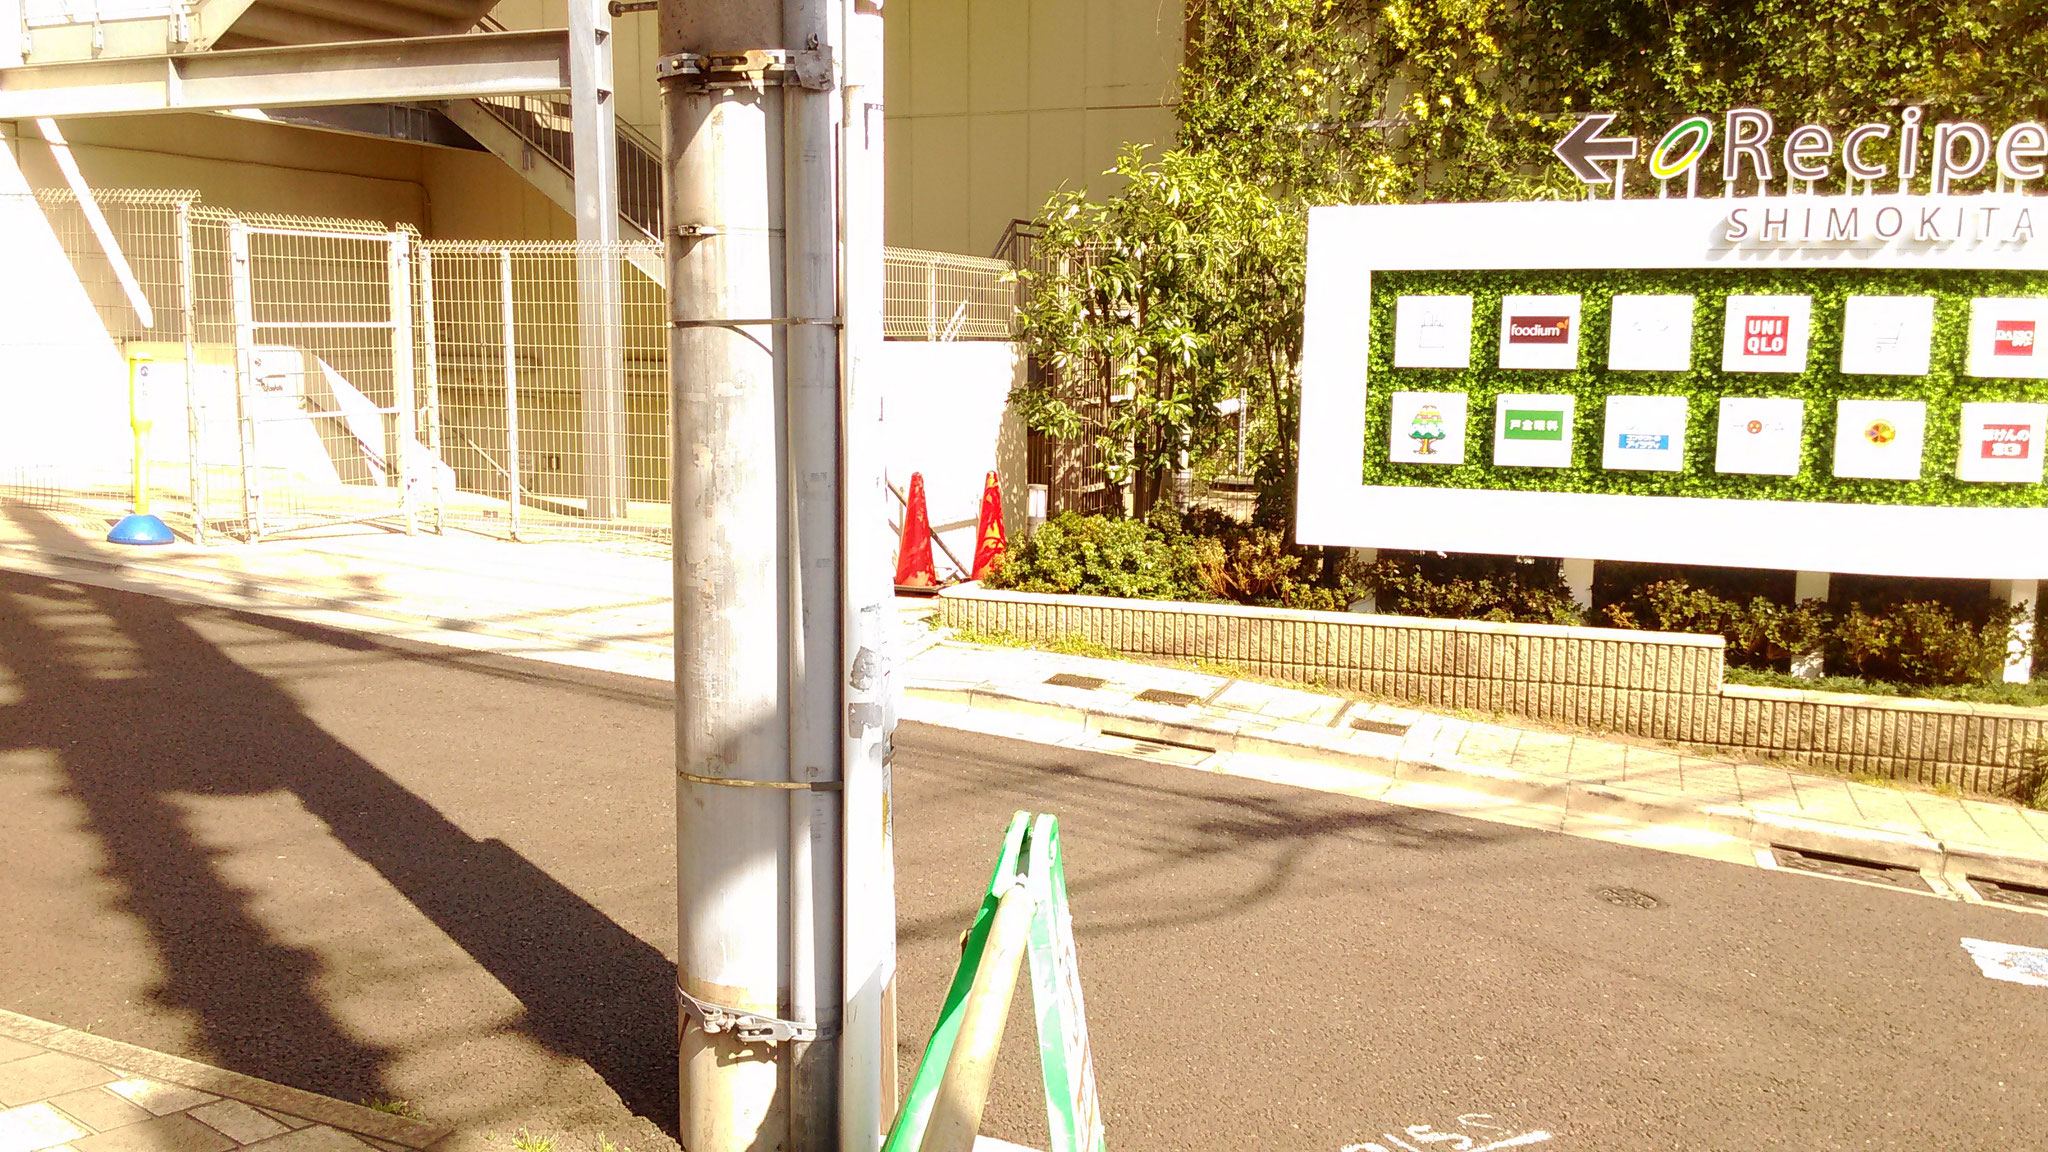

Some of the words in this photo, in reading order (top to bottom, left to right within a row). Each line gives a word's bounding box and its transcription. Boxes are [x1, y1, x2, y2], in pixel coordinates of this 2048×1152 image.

[1723, 106, 2048, 196] Recipe
[1726, 206, 2035, 241] SHIMOKITA
[1511, 323, 1561, 337] foodium
[1748, 319, 1782, 335] UNI
[1747, 336, 1784, 354] QLO
